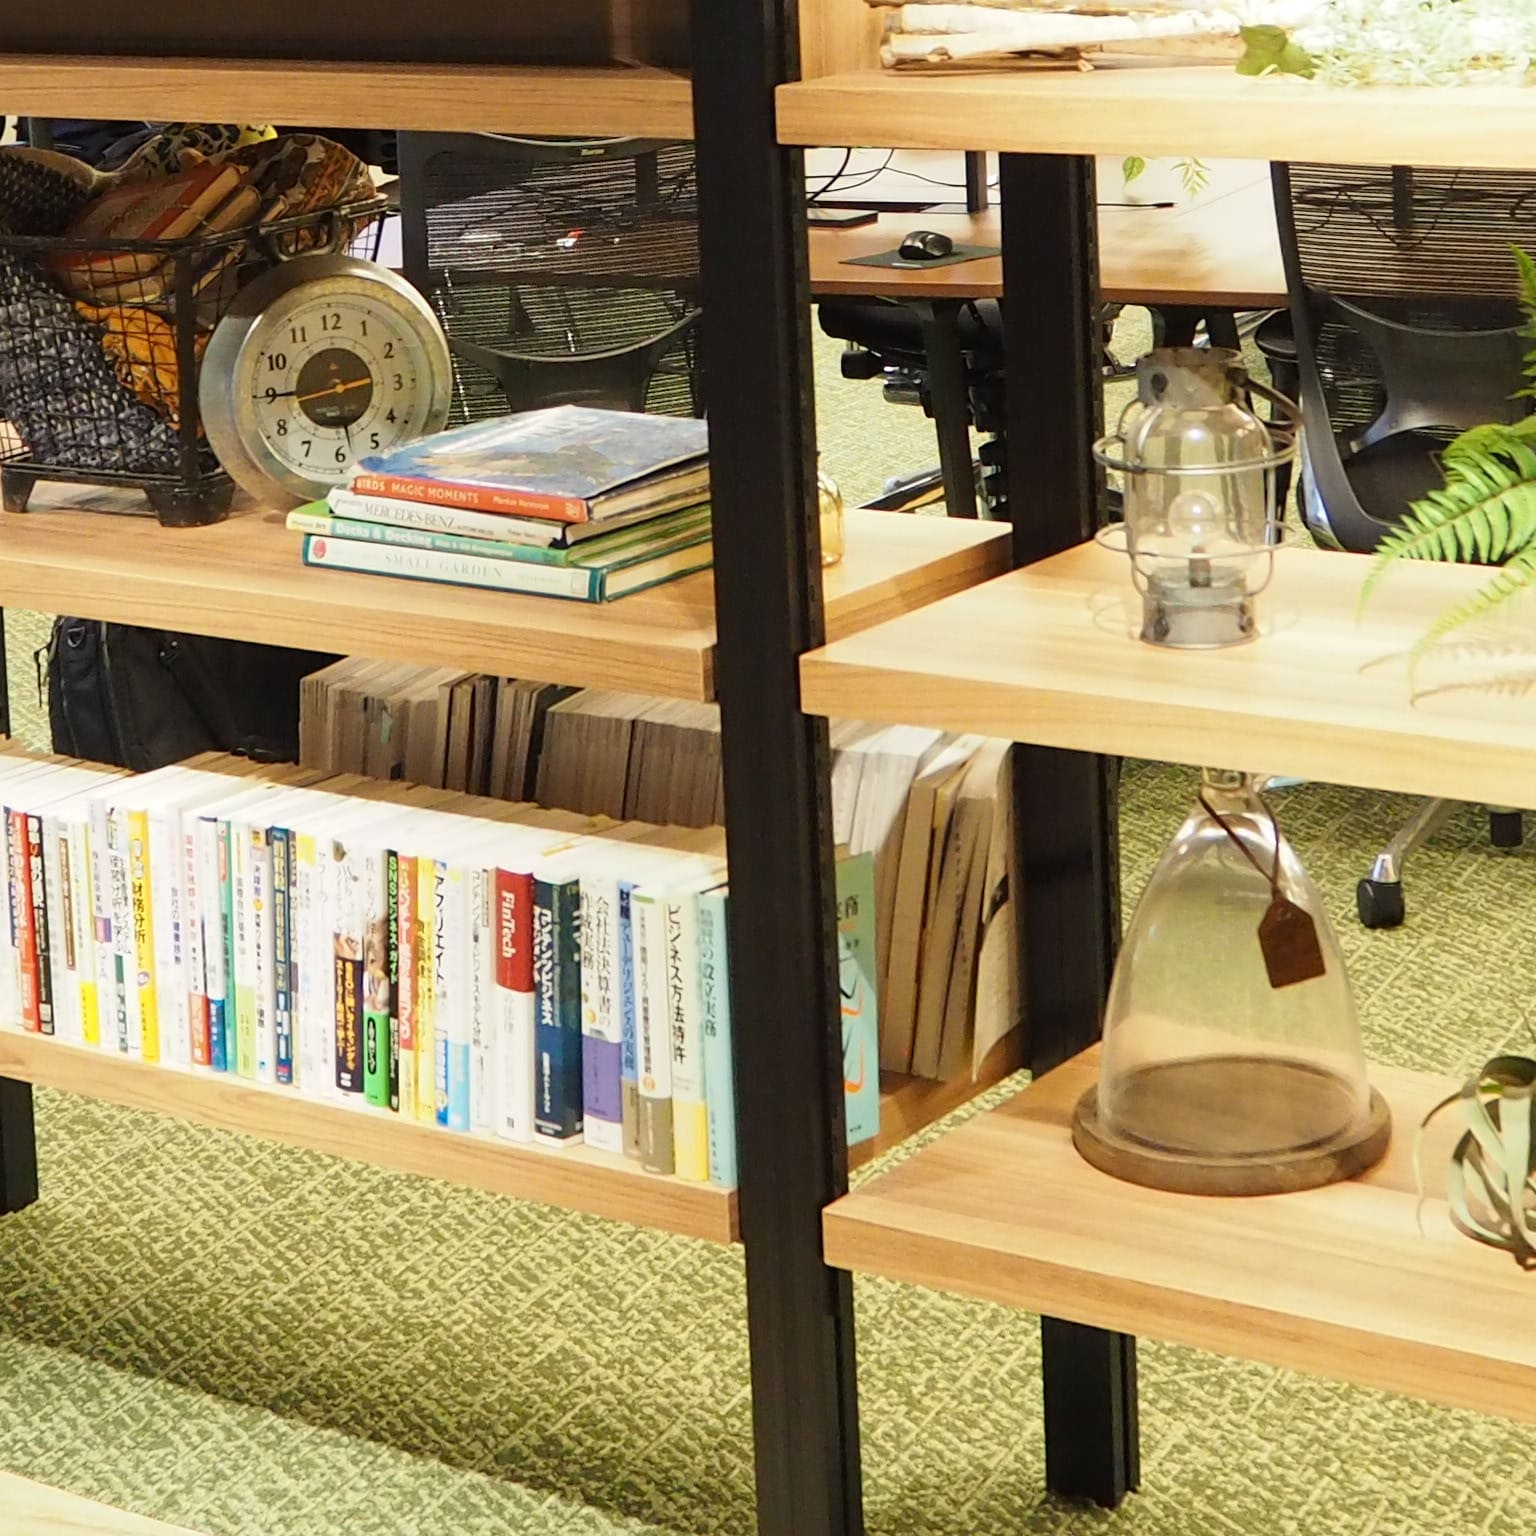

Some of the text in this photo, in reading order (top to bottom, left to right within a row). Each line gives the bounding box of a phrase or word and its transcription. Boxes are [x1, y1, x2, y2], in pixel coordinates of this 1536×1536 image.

[320, 313, 342, 331] 12
[360, 320, 368, 337] 1
[291, 326, 307, 344] 11
[383, 342, 394, 359] 2
[267, 353, 287, 371] 10
[393, 374, 403, 391] 3
[265, 387, 277, 404] 9
[385, 408, 397, 424] 4
[276, 419, 287, 436] 8
[301, 440, 312, 458] 7
[370, 432, 380, 450] 5
[335, 445, 346, 463] 6
[356, 478, 385, 493] BIRDS
[391, 483, 425, 496] MAGIC
[428, 487, 479, 504] MOMENTS
[385, 552, 503, 578] SMALL GARDEN
[501, 890, 516, 958] FinTech
